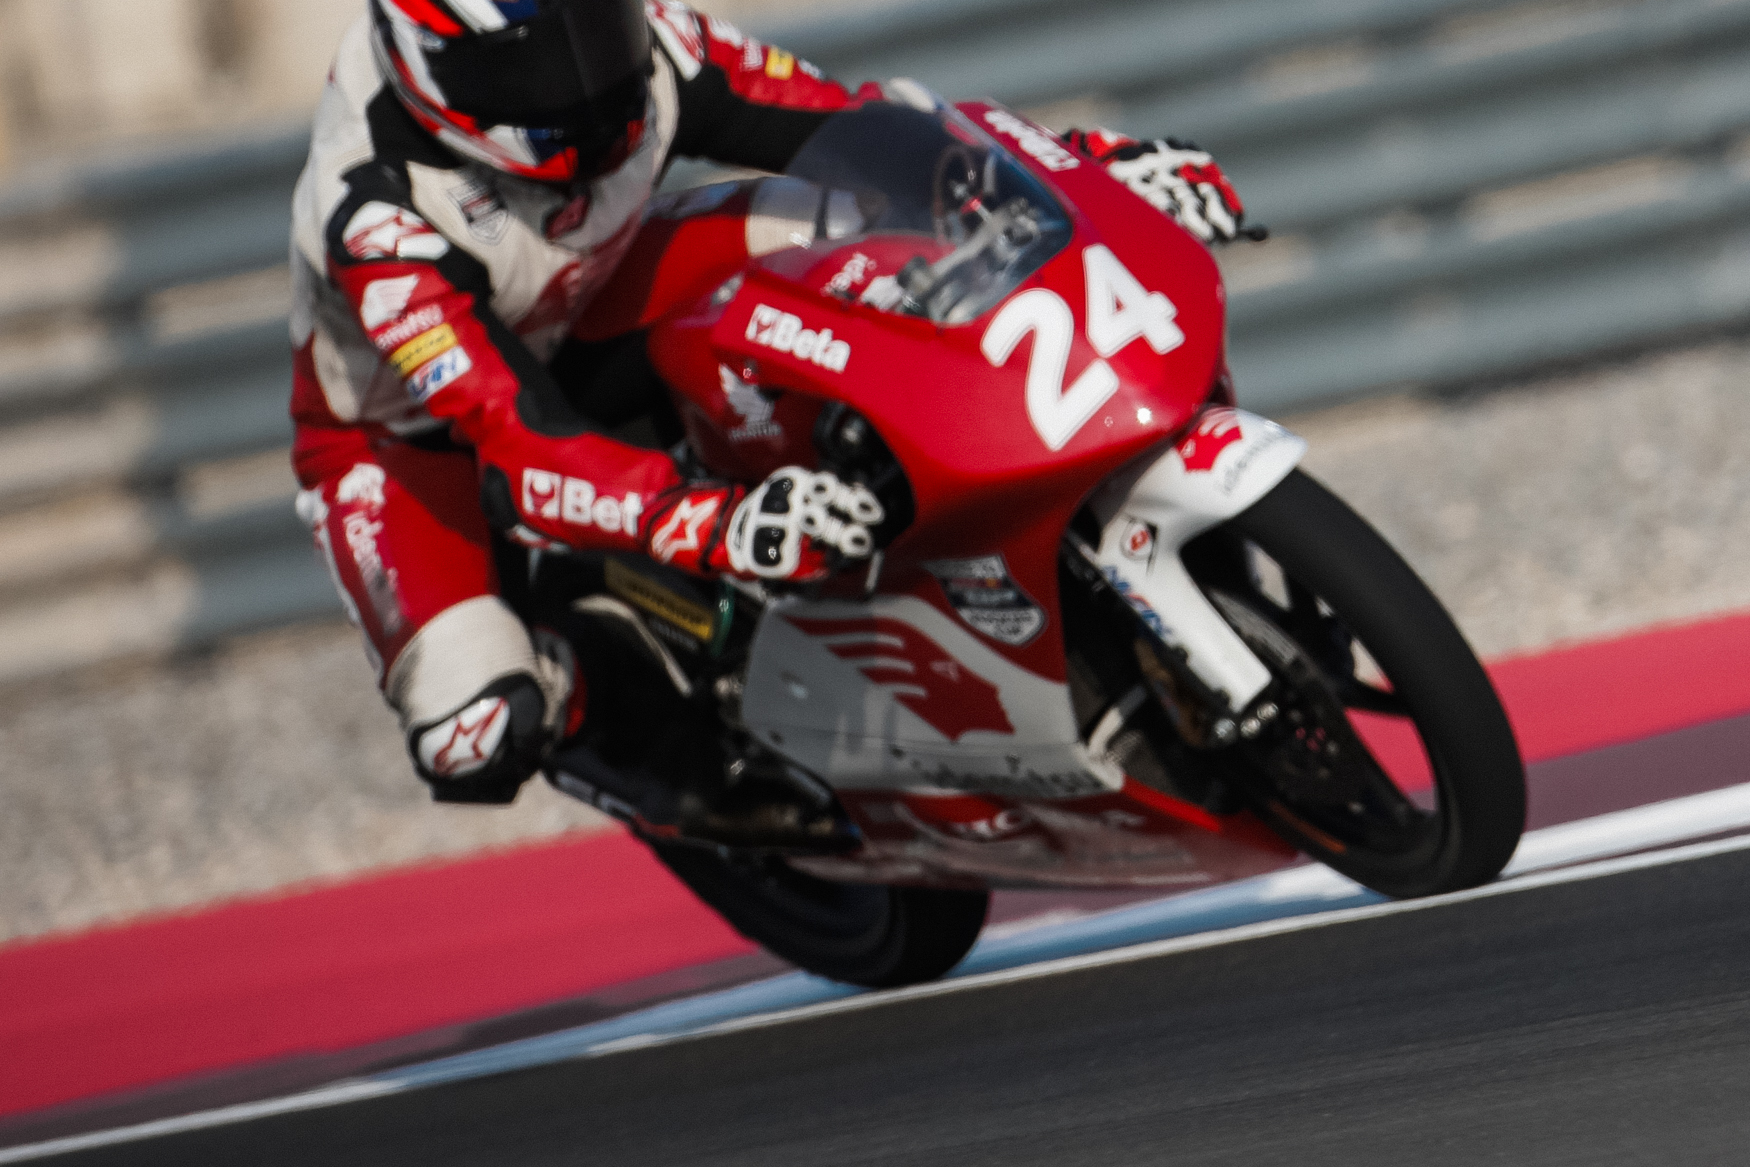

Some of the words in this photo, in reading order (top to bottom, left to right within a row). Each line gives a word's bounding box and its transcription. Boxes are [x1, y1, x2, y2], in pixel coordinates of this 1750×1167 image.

[771, 312, 851, 374] Beta
[980, 244, 1185, 451] 24
[561, 476, 645, 537] Bet
